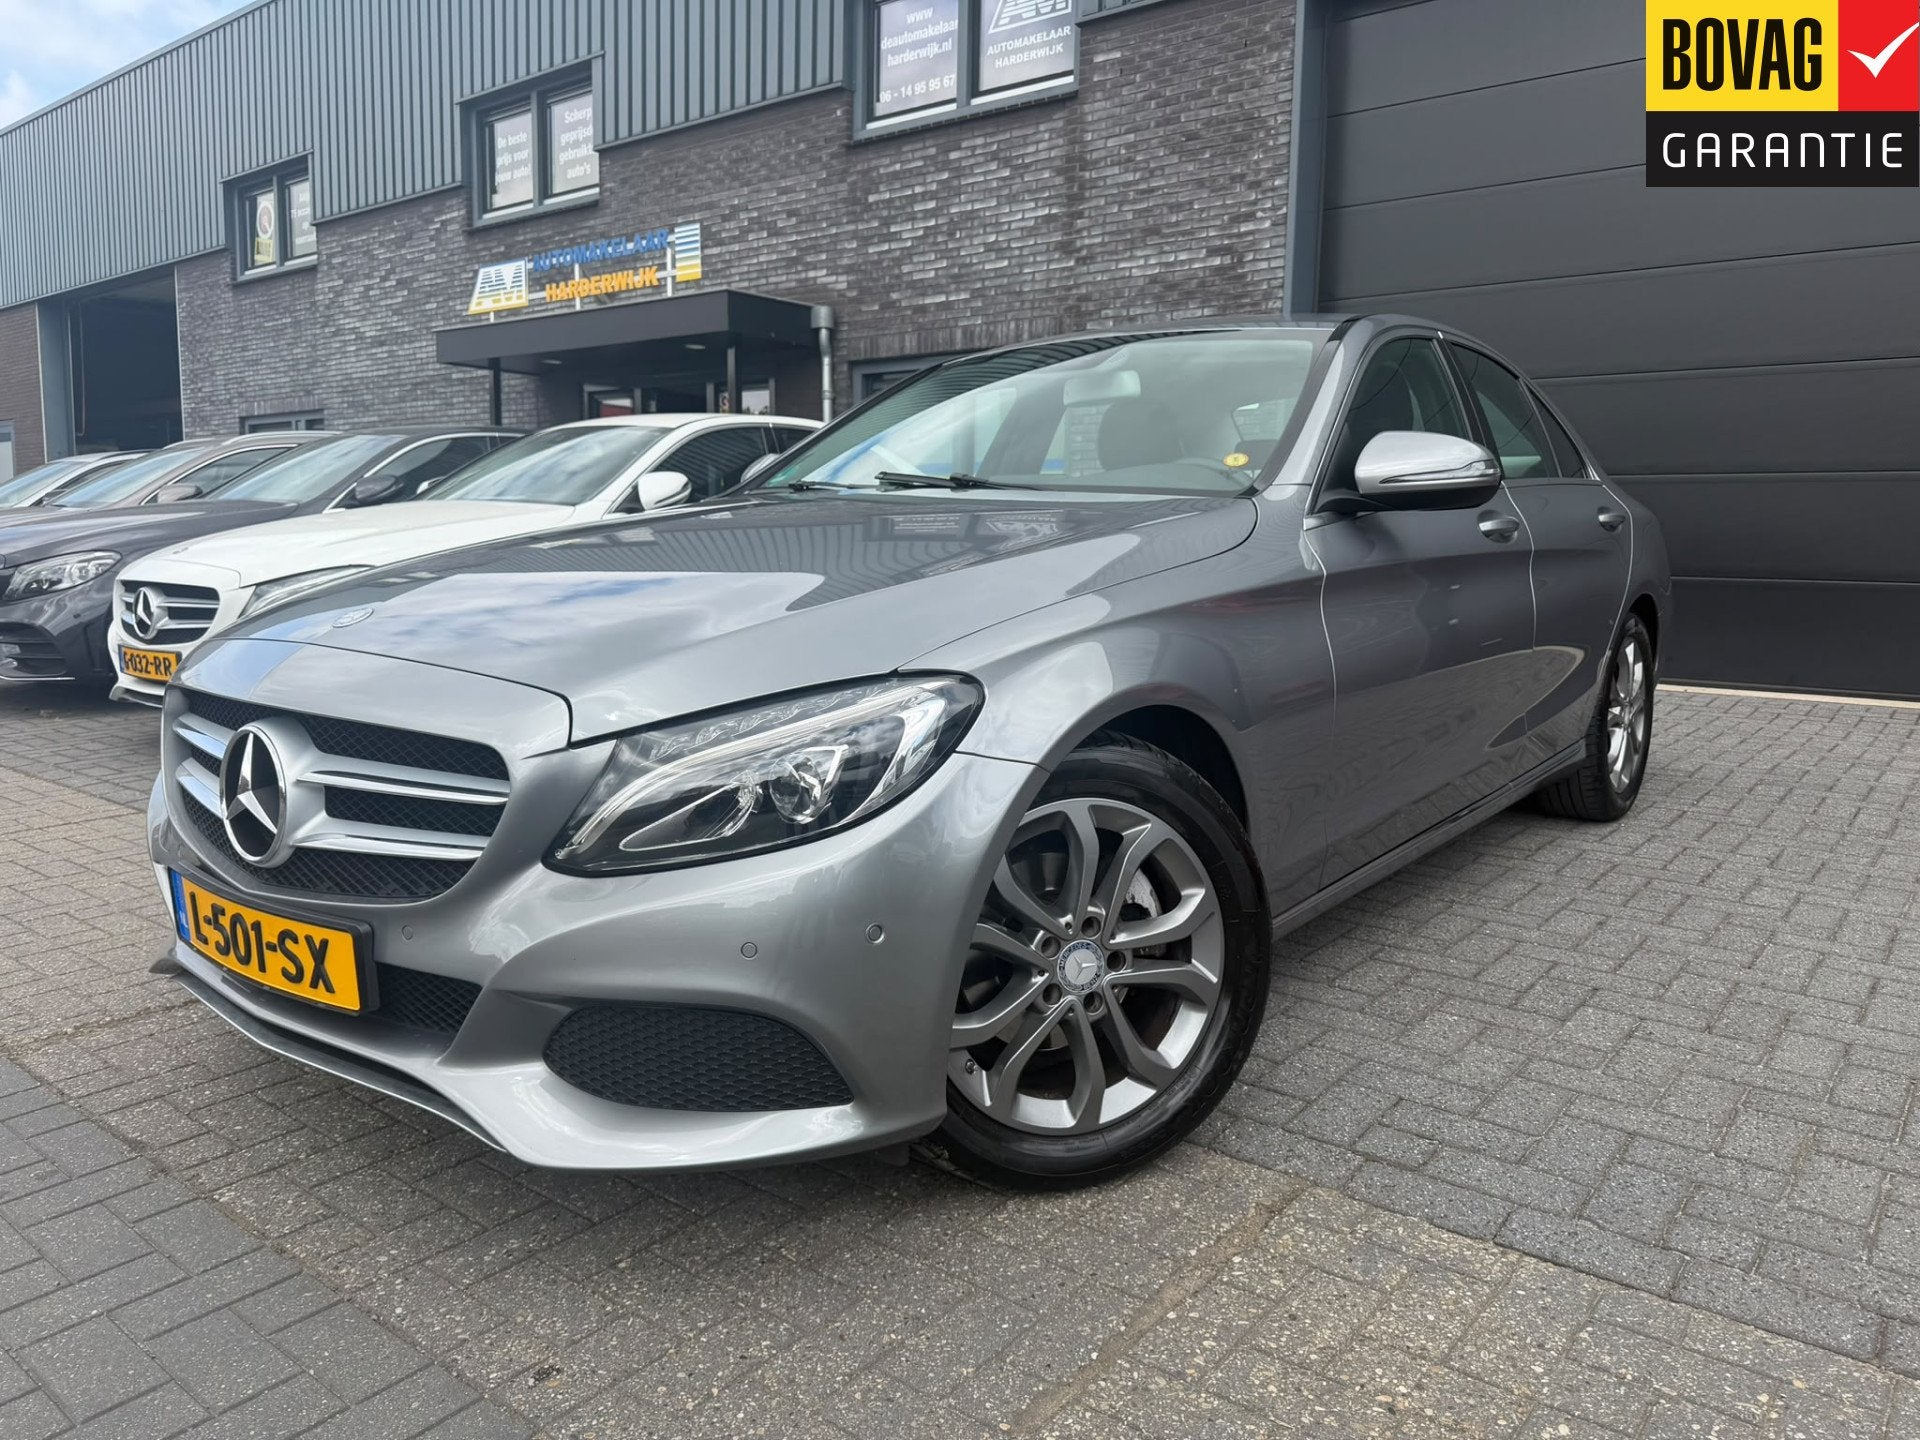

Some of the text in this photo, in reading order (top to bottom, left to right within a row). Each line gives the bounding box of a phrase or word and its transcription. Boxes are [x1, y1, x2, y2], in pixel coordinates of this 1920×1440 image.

[906, 7, 933, 24] www
[887, 37, 952, 67] harderwijk.nl
[986, 25, 1071, 56] AUTOMAKELAAR
[995, 42, 1064, 68] HARDERWIJK
[901, 84, 912, 98] 14
[943, 74, 956, 88] 67
[533, 228, 670, 272] AUTOMAKELAAR
[545, 266, 660, 302] HARDERWIJK
[189, 891, 335, 994] L-501-SX
